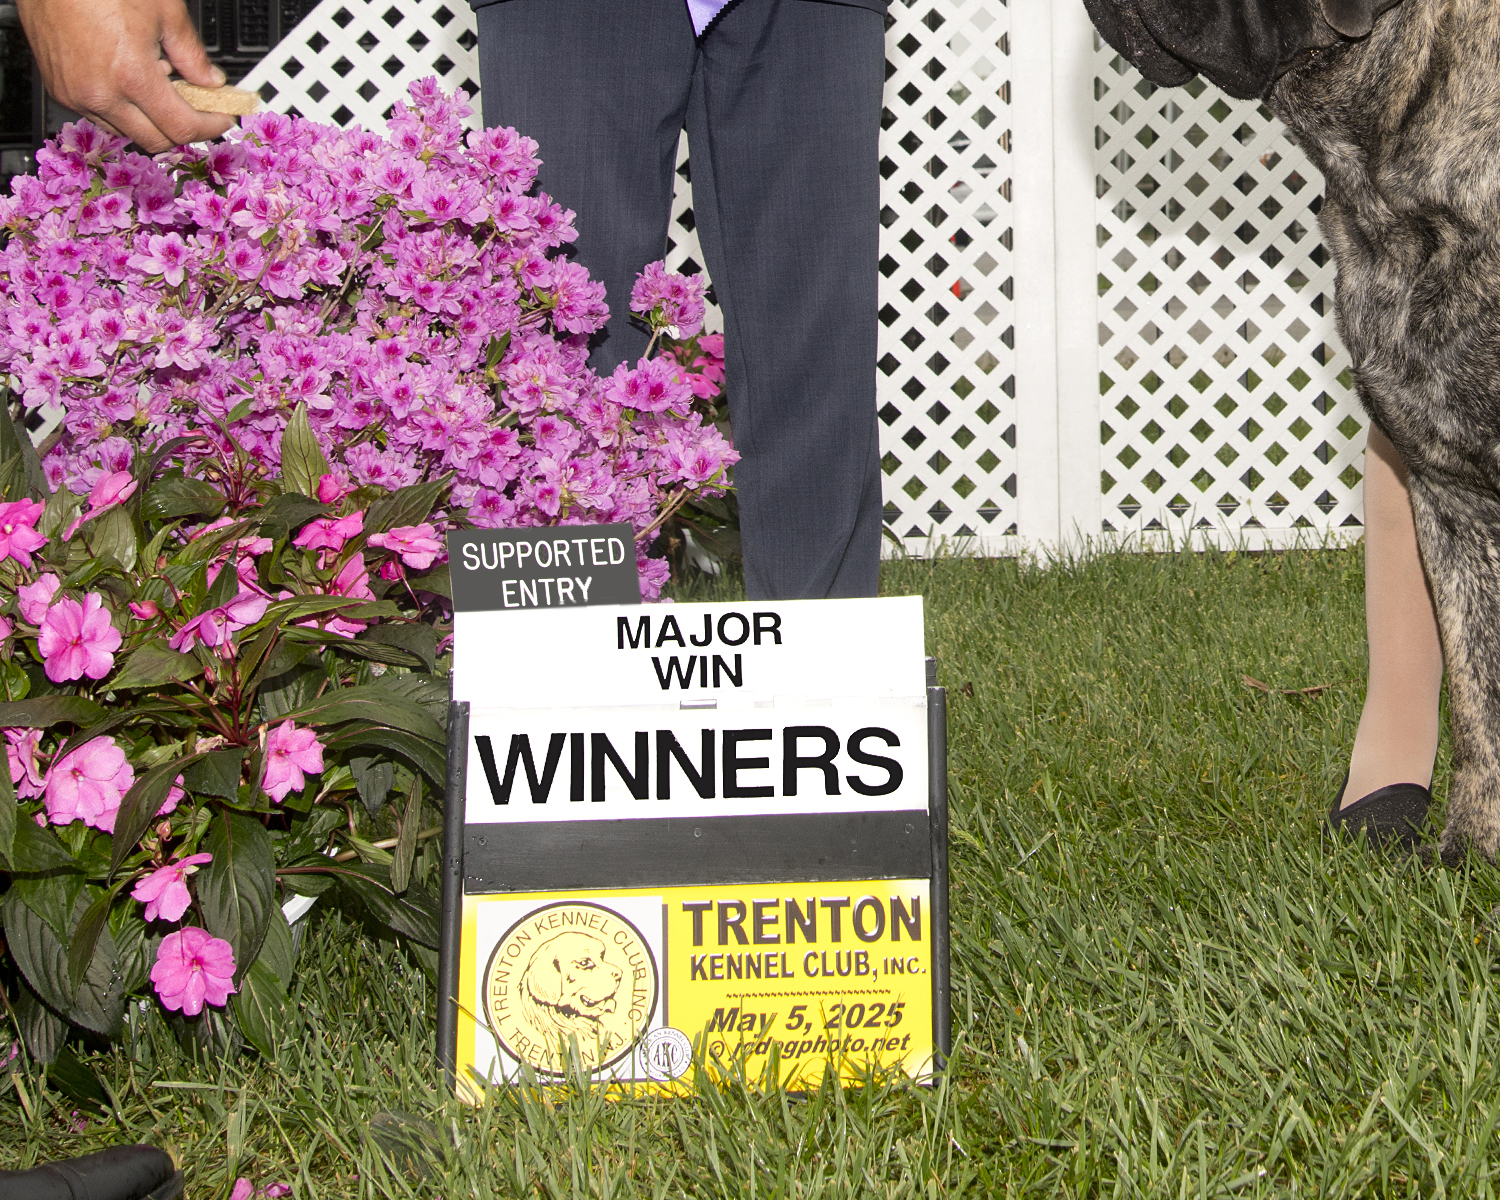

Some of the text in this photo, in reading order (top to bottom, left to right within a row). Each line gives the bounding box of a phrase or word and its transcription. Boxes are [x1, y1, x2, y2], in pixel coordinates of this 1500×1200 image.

[462, 537, 626, 571] SUPPORTED
[501, 575, 593, 608] ENTRY
[616, 612, 783, 649] MAJOR
[651, 653, 744, 690] WIN
[474, 725, 904, 806] WINNERS
[682, 894, 922, 947] TRENTON
[493, 929, 532, 1026] TRENTON
[534, 911, 610, 935] KENNEL
[614, 930, 648, 981] CLUB
[690, 949, 927, 982] KENNEL CLUB, INC.
[708, 1002, 906, 1039] May 5, 2025
[509, 1027, 595, 1068] TRENTN
[653, 1042, 679, 1068] AKC
